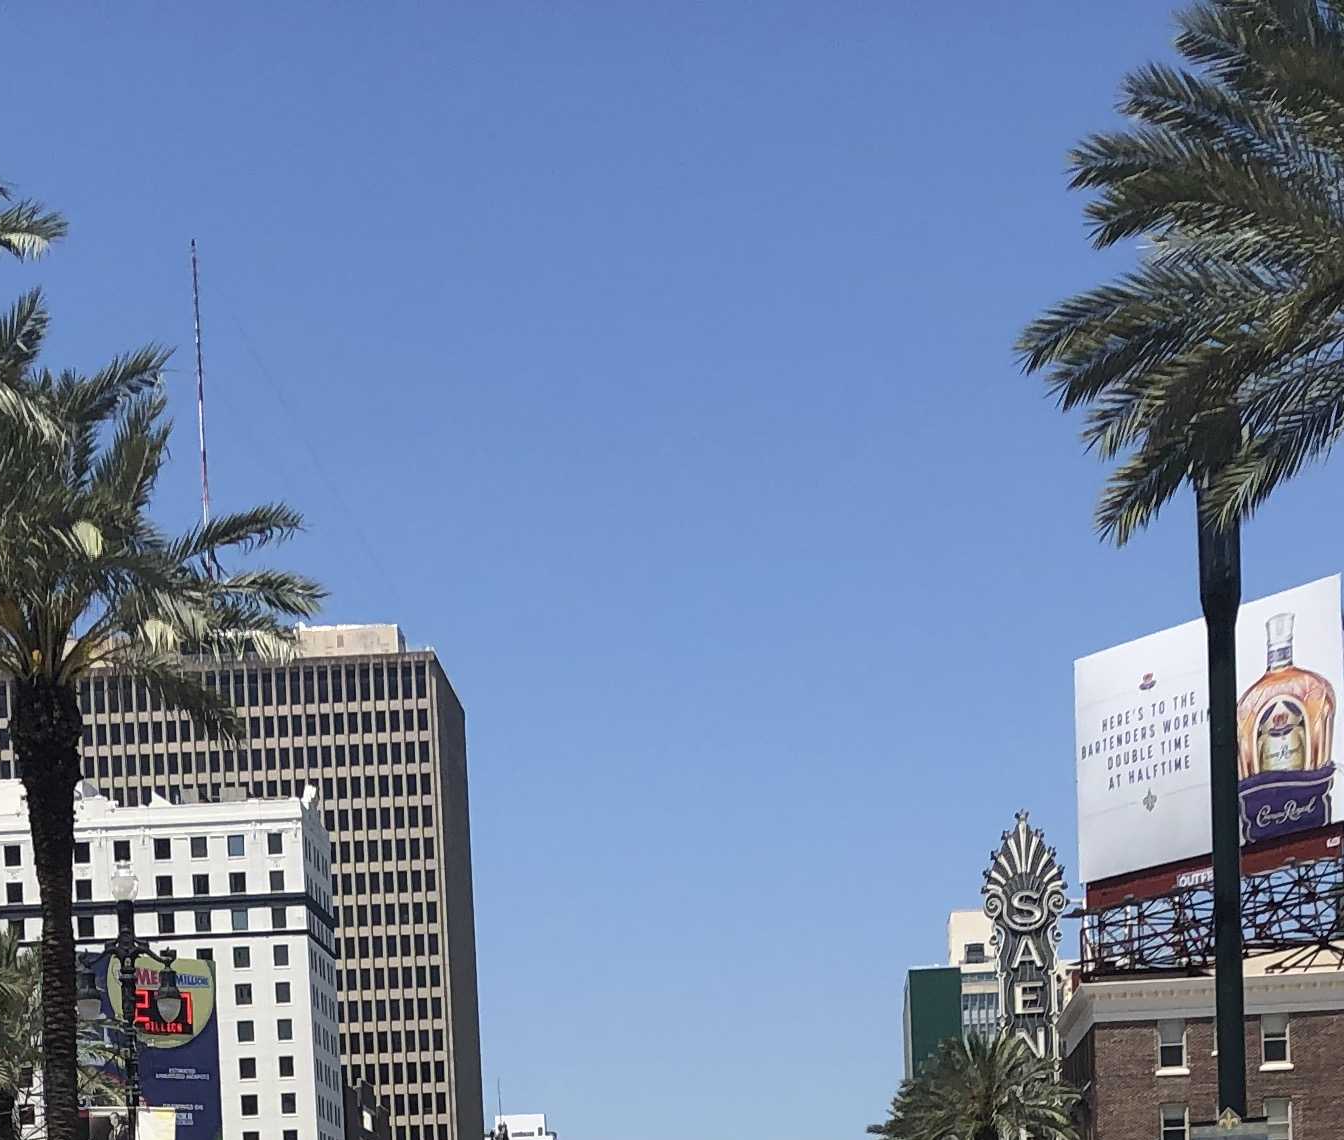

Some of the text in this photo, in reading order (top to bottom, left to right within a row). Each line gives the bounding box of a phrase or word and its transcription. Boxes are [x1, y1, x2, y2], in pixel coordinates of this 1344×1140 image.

[1102, 691, 1196, 733] HERE'S TO THE
[1081, 723, 1156, 761] BARTENDERS
[1107, 733, 1190, 771] DOUBLE TIME
[1108, 754, 1190, 791] AT HALFTIME
